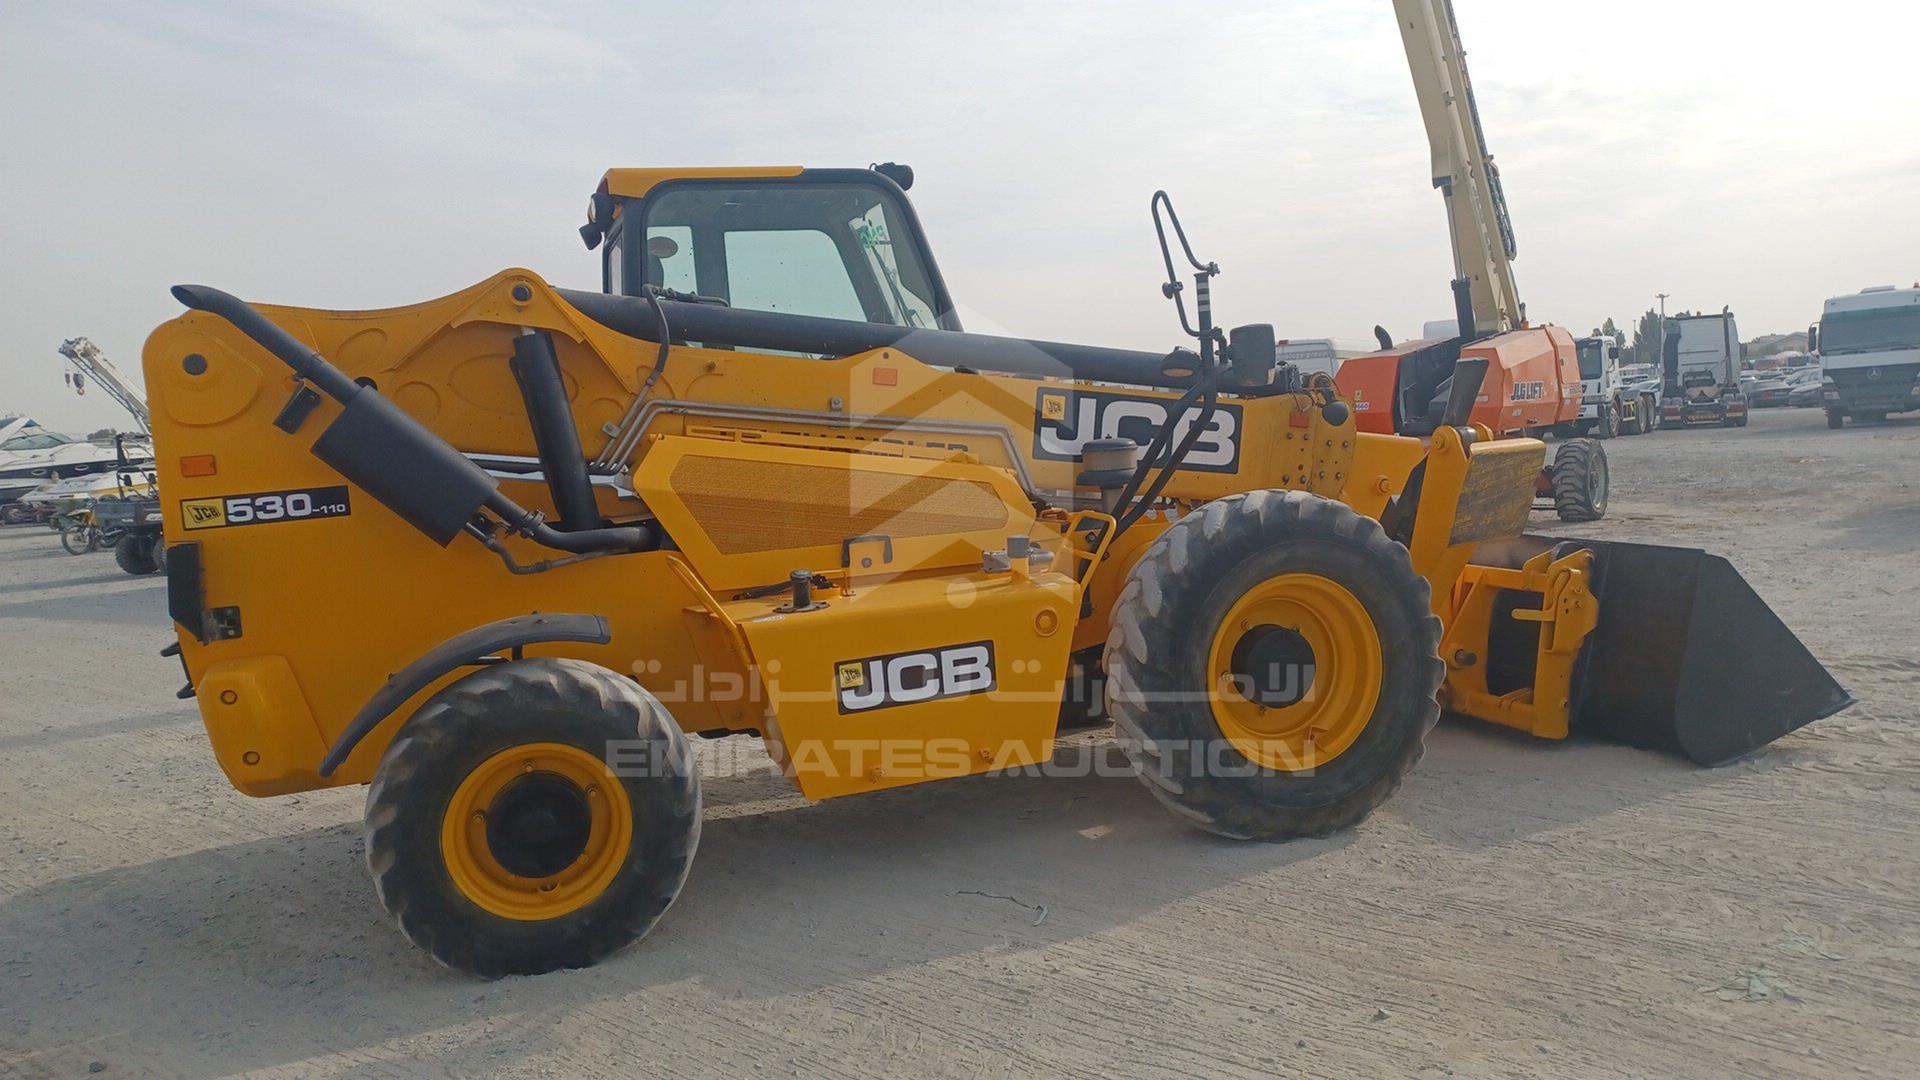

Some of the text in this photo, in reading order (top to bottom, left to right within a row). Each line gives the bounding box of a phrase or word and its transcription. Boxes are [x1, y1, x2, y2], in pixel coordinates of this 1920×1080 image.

[1040, 397, 1236, 466] JCB
[194, 493, 346, 523] JCB 530-110
[841, 645, 992, 710] JCB
